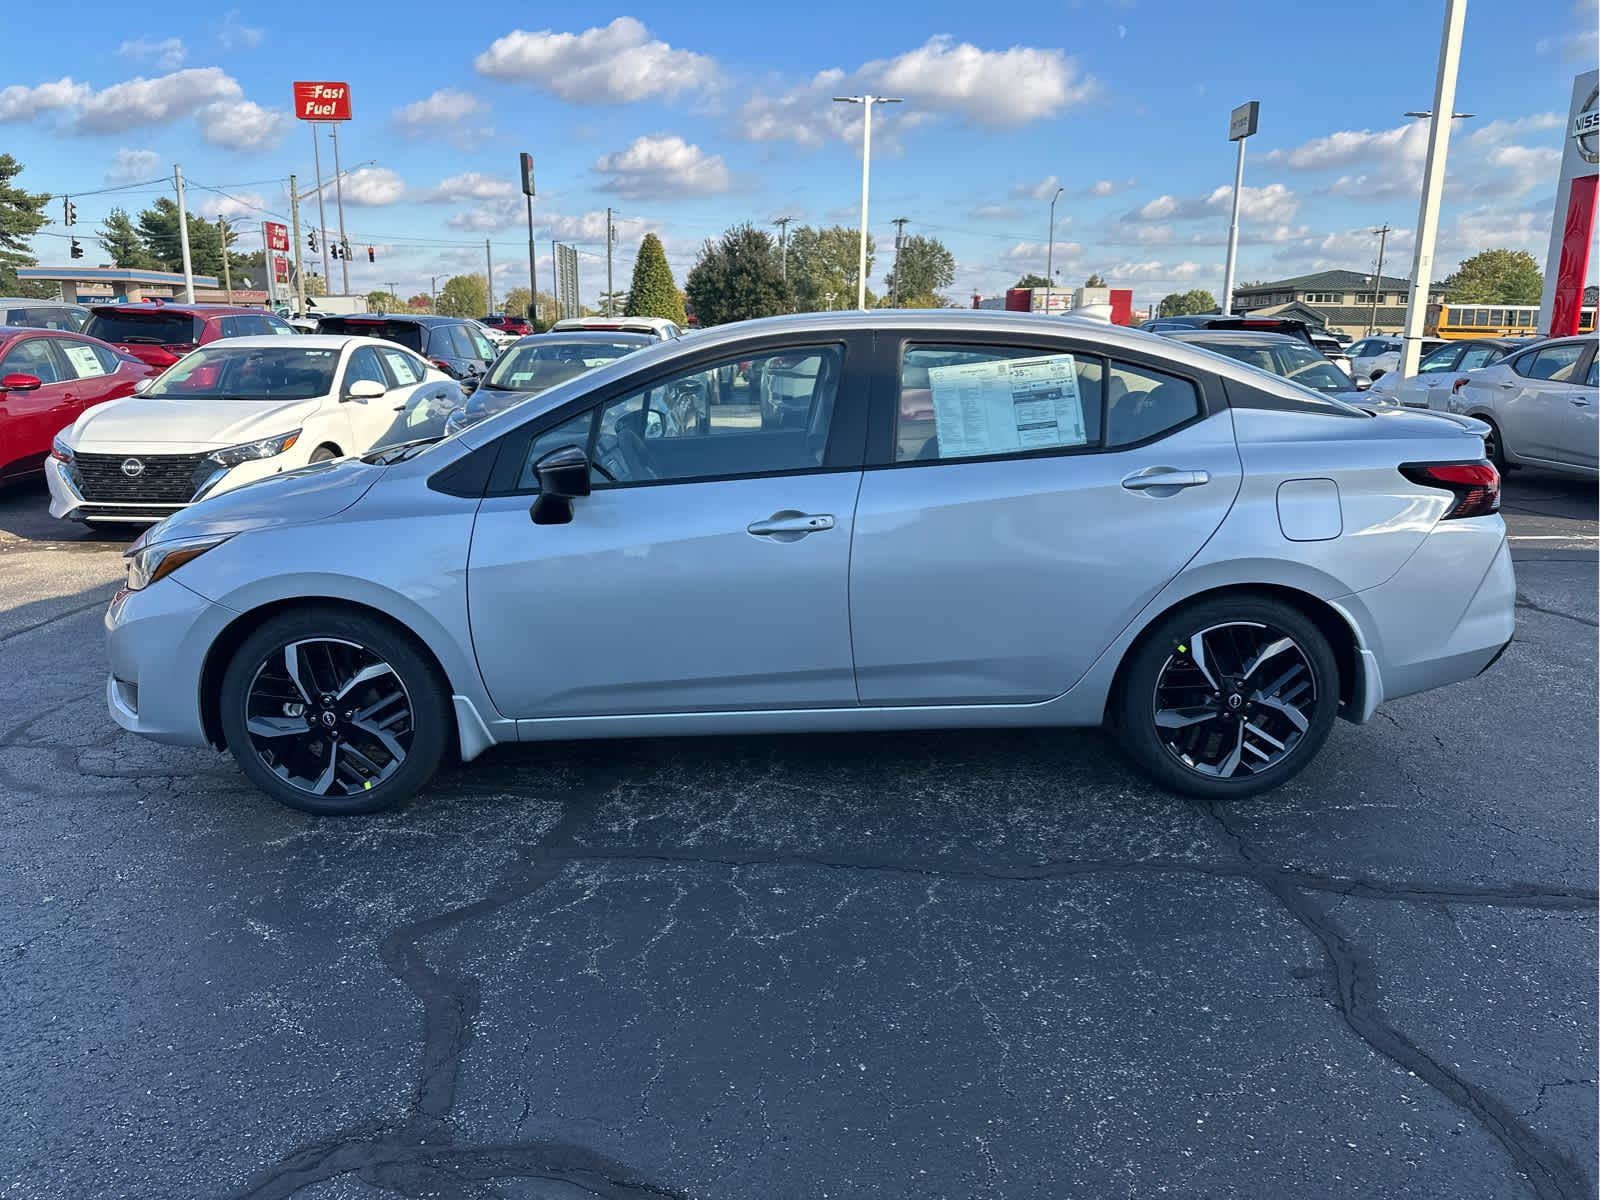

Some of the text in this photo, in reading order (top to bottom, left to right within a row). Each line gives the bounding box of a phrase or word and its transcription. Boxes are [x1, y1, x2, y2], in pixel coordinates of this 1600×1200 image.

[314, 85, 344, 98] Fast
[305, 101, 336, 115] Fuel
[272, 237, 285, 249] Fuel
